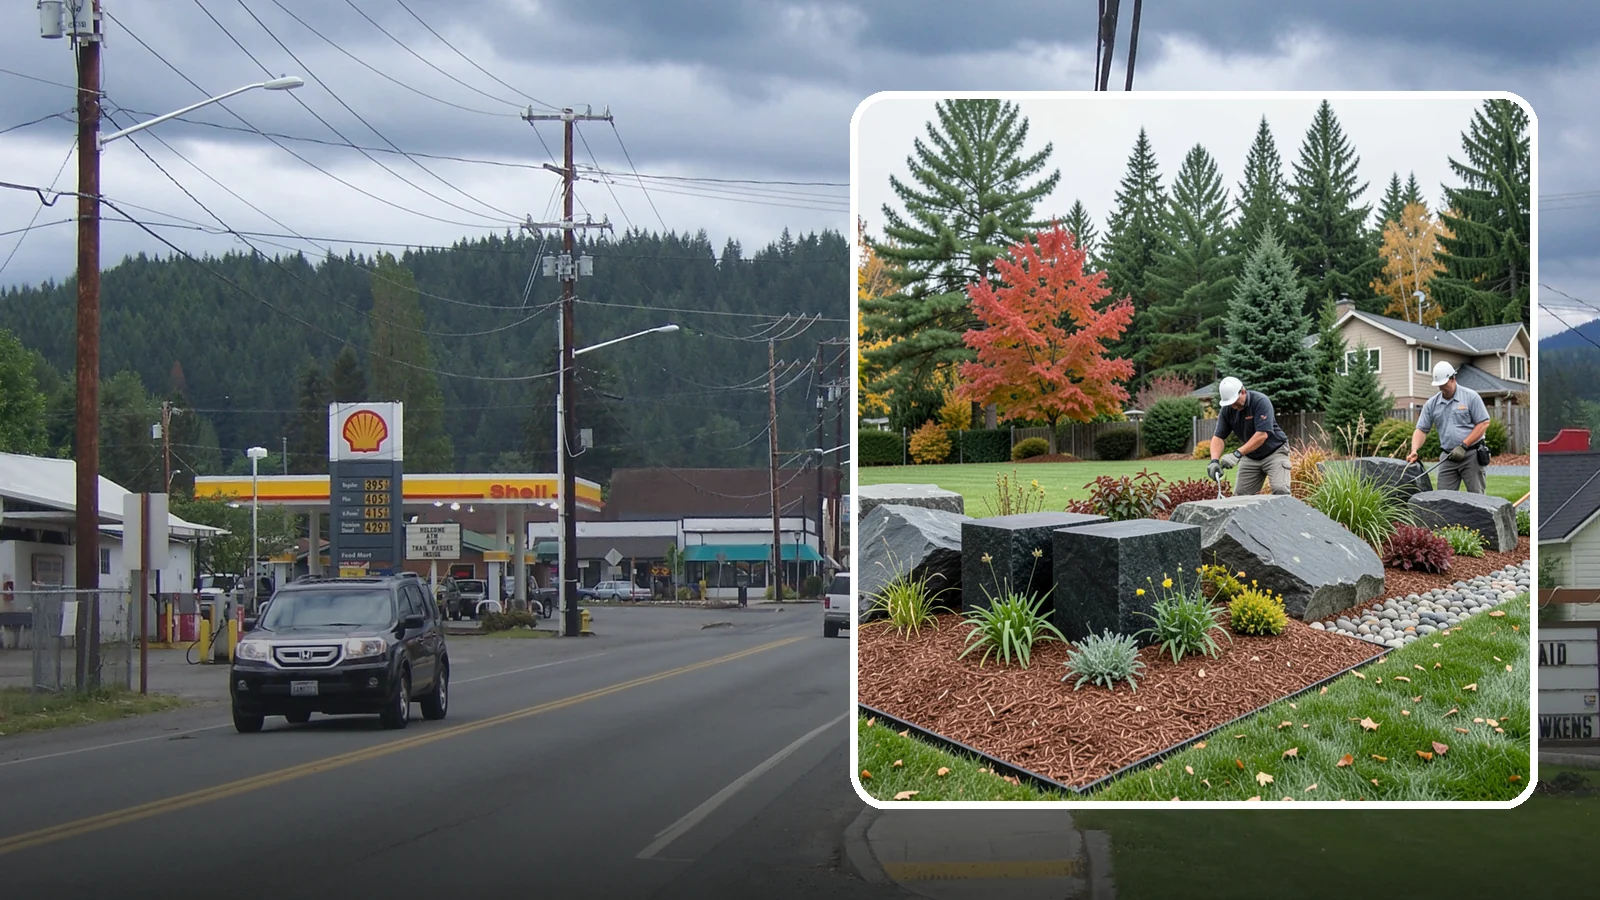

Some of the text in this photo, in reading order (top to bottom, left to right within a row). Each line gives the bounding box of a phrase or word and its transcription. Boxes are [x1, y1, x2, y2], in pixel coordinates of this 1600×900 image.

[366, 480, 383, 490] 395
[490, 484, 547, 499] Shell
[366, 494, 383, 504] 405
[366, 508, 383, 518] 415
[366, 522, 383, 532] 429
